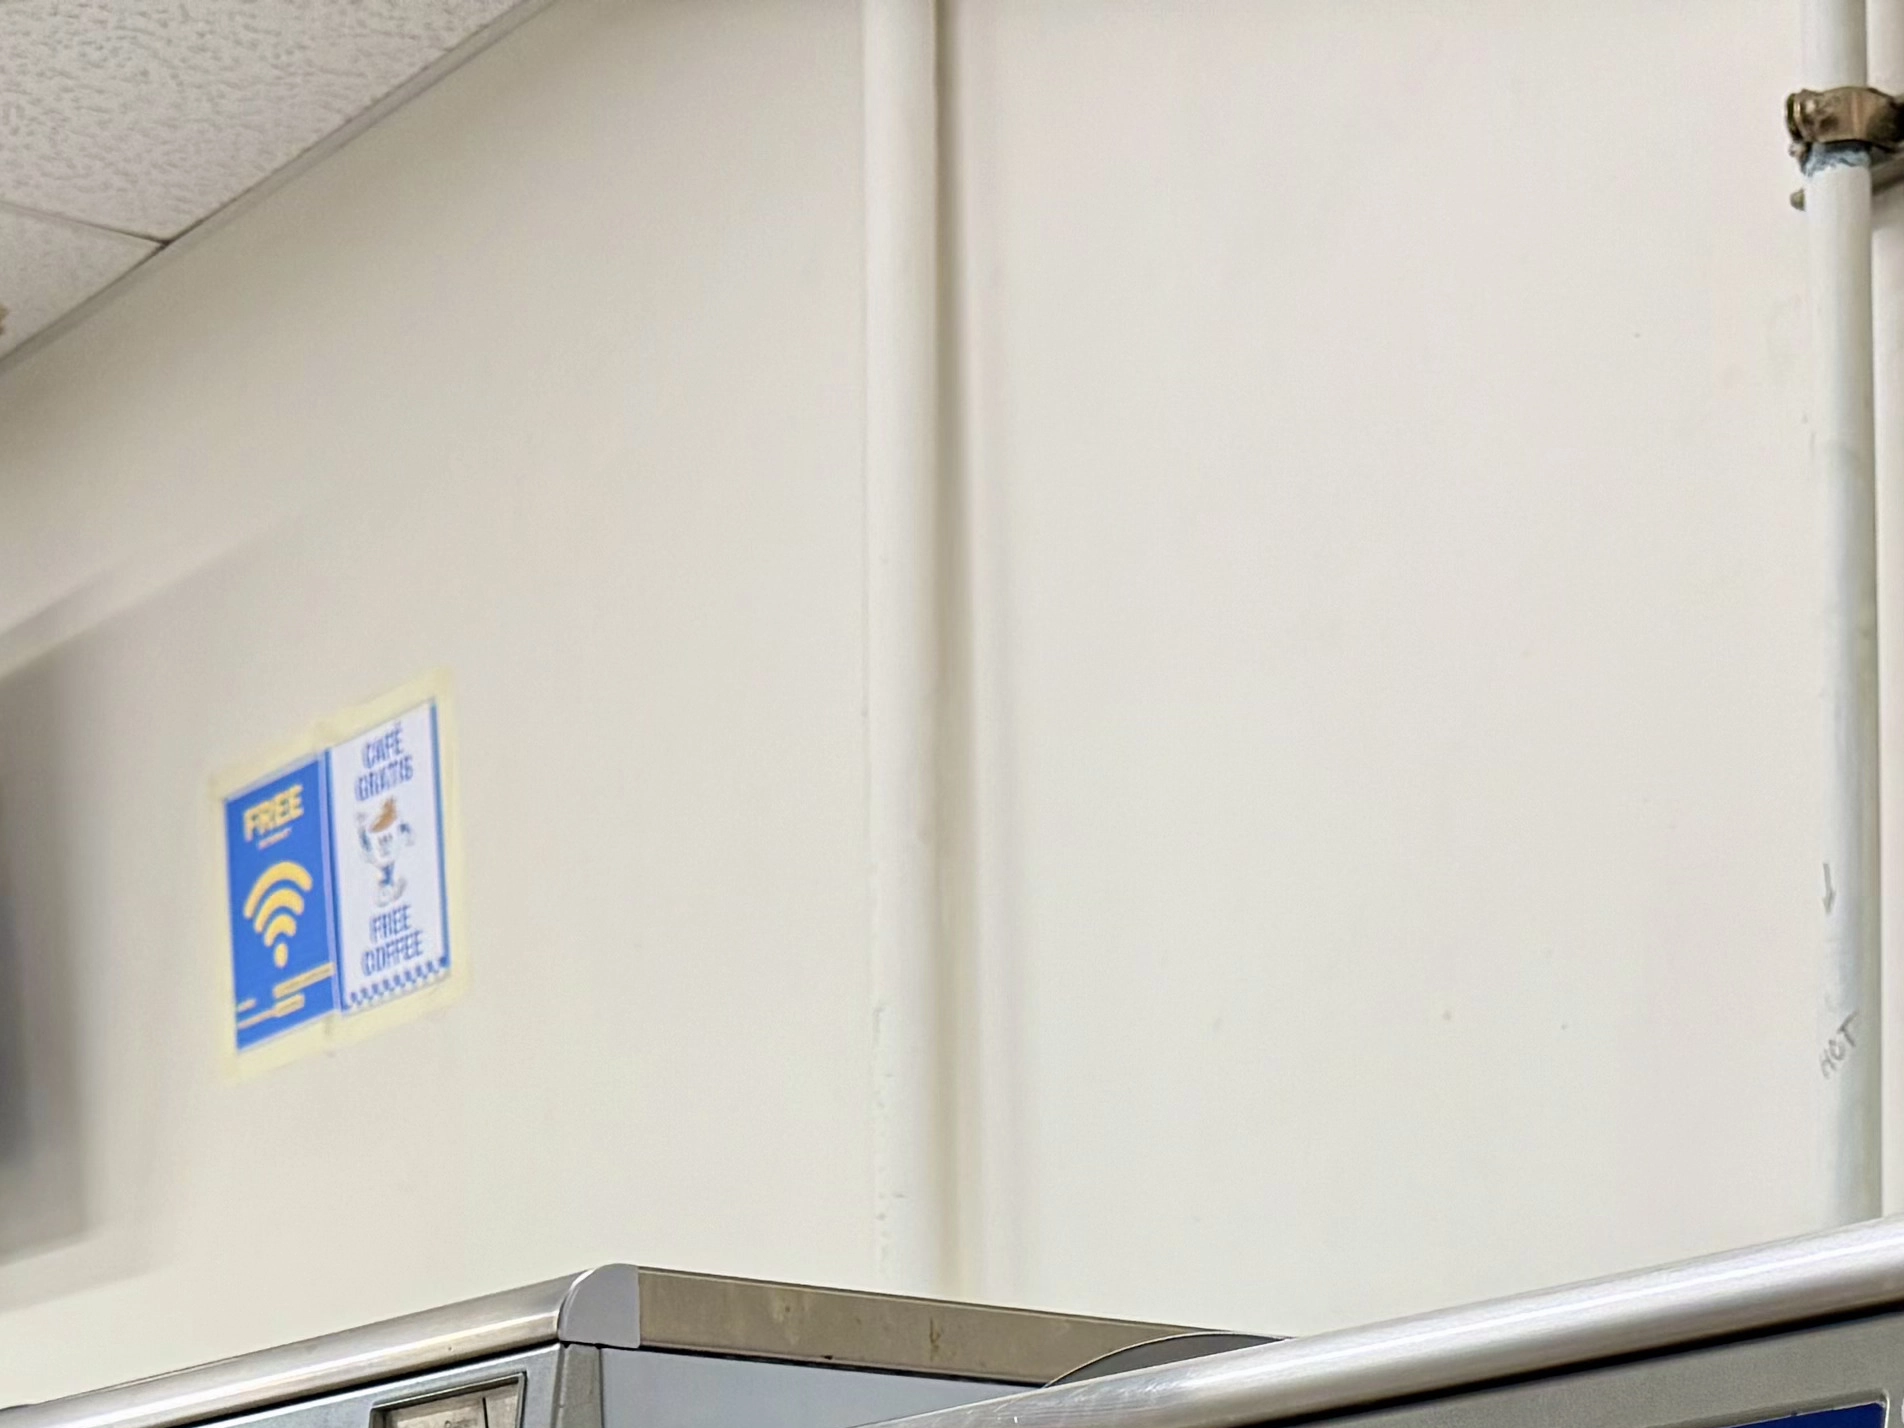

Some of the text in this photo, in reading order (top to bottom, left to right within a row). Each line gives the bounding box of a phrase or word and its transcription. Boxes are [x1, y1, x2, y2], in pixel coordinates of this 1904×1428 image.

[242, 785, 304, 842] FREE
[369, 904, 411, 943] FREE
[360, 930, 423, 977] COFFEE
